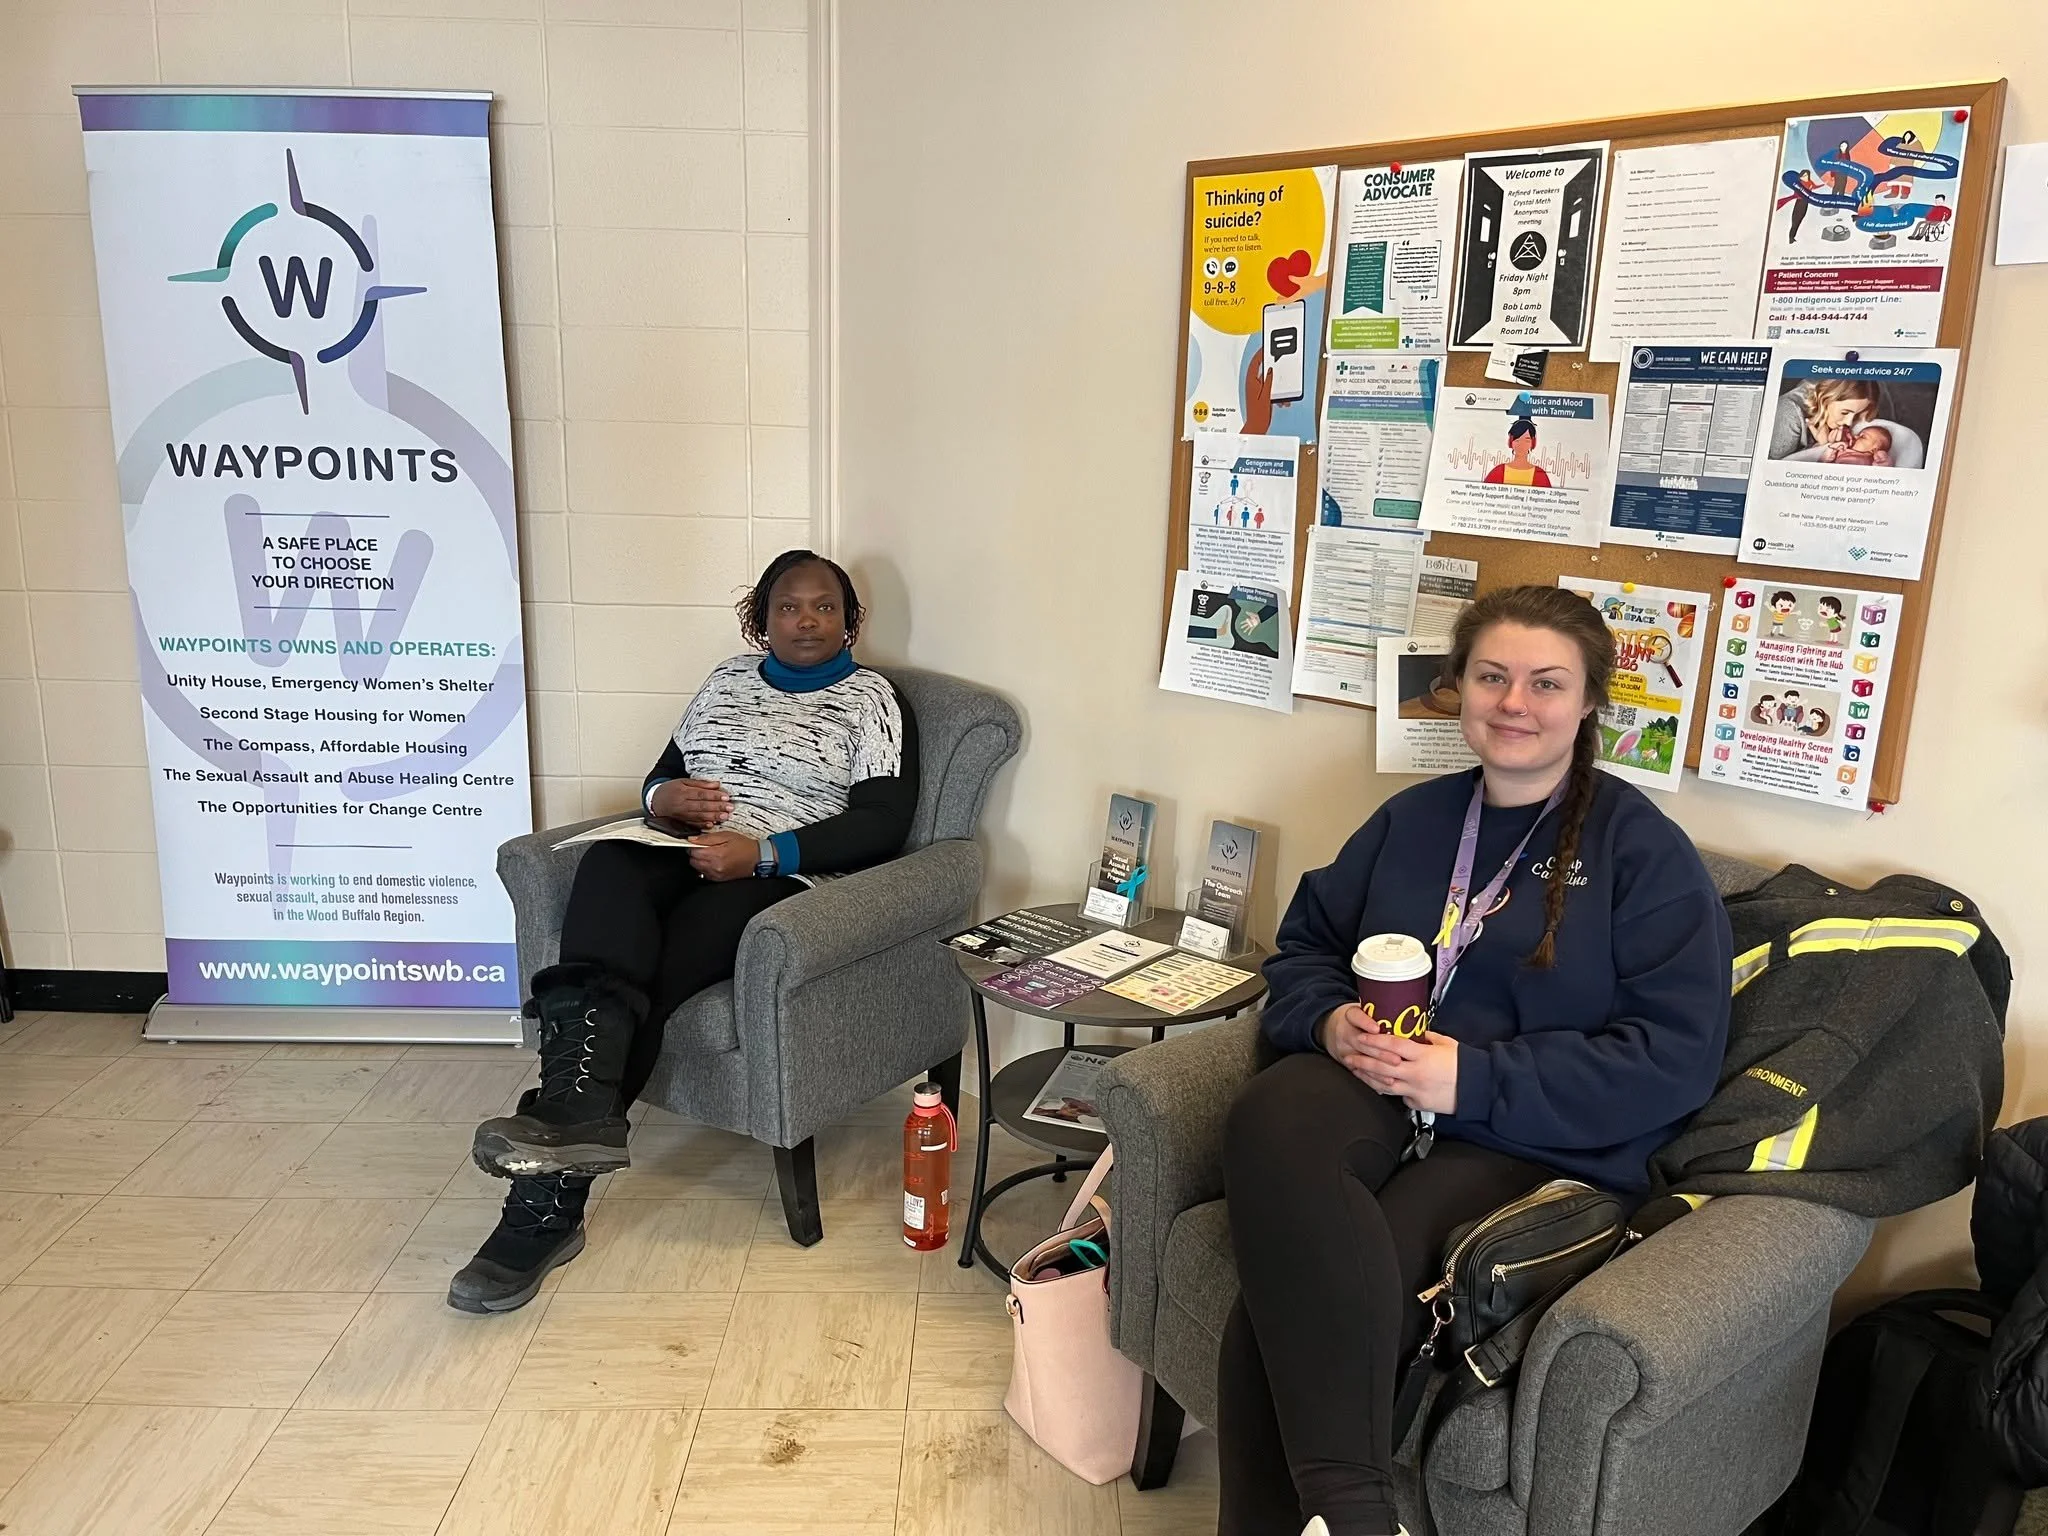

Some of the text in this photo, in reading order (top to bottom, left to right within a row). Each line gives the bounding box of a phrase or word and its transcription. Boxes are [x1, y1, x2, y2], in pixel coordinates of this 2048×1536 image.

[1364, 168, 1436, 187] CONSUMER
[1505, 167, 1565, 181] Welcome to
[1205, 185, 1284, 207] Thinking of
[1363, 183, 1432, 201] ADVOCATE
[1532, 188, 1560, 196] Tweakers
[1513, 199, 1534, 207] Crystal
[1514, 208, 1549, 216] Anonymous
[1205, 211, 1262, 229] suicide?
[1517, 218, 1542, 226] meeting
[1499, 273, 1549, 283] Friday Night
[1778, 271, 1803, 279] Patient
[258, 255, 333, 319] W
[1204, 281, 1236, 294] 9-8-8
[1512, 287, 1531, 297] 8pm
[1503, 303, 1518, 311] Bob
[1794, 296, 1842, 305] Indigenous
[1843, 295, 1878, 304] Support
[1880, 295, 1902, 303] Line:
[1505, 315, 1537, 324] Building
[1790, 313, 1868, 321] 1-844-944-4744
[1524, 327, 1540, 335] 104
[1785, 327, 1830, 335] ahs.ca/ISL
[1700, 351, 1768, 365] WE CAN HELP
[1811, 365, 1913, 376] Seek expert advice 24/7
[1547, 398, 1562, 406] and
[1562, 399, 1583, 407] Mood
[1531, 407, 1576, 417] with Tammy
[166, 443, 458, 483] WAYPOINTS
[1245, 459, 1273, 468] Genogram
[1269, 469, 1289, 477] Making
[1785, 471, 1900, 486] Concerned about your newborn?
[1764, 480, 1919, 497] Questions about mom's post-partum health?
[1800, 492, 1829, 501] Nervous
[1847, 497, 1875, 505] parent?
[262, 536, 378, 552] A SAFE PLACE
[272, 556, 372, 571] TO CHOOSE
[1425, 559, 1470, 574] BOREAL
[251, 575, 394, 591] YOUR DIRECTION
[1624, 612, 1656, 624] SPACE
[159, 637, 496, 657] WAYPOINTS OWNS AND OPERATES:
[1759, 640, 1843, 659] Managing Fighting and
[1754, 650, 1844, 670] Aggression with The Hub
[167, 674, 495, 693] Unity House, Emergency Women’s Shelter
[200, 707, 466, 725] Second Stage Housing for Women
[202, 738, 468, 758] The Compass, Affordable Housing
[1740, 730, 1833, 754] Developing Healthy Screen
[1741, 741, 1829, 764] Time Habits with The Hub
[163, 768, 514, 788] The Sexual Assault and Abuse Healing Centre
[197, 800, 483, 818] The Opportunities for Change Centre
[1111, 836, 1135, 847] WAYPOINTS
[1108, 859, 1126, 871] Assault
[1112, 853, 1129, 864] Sexual
[1110, 867, 1126, 877] Abuse
[1211, 865, 1242, 878] WAYPOINTS
[214, 872, 477, 889] Waypoints is working to end domestic violence,
[1204, 878, 1243, 896] The Outreach
[237, 891, 459, 905] sexual assault, abuse and homelessness
[1215, 889, 1231, 900] Team
[274, 909, 425, 925] in the Wood Buffalo Region.
[198, 958, 506, 987] www.waypointswb.ca
